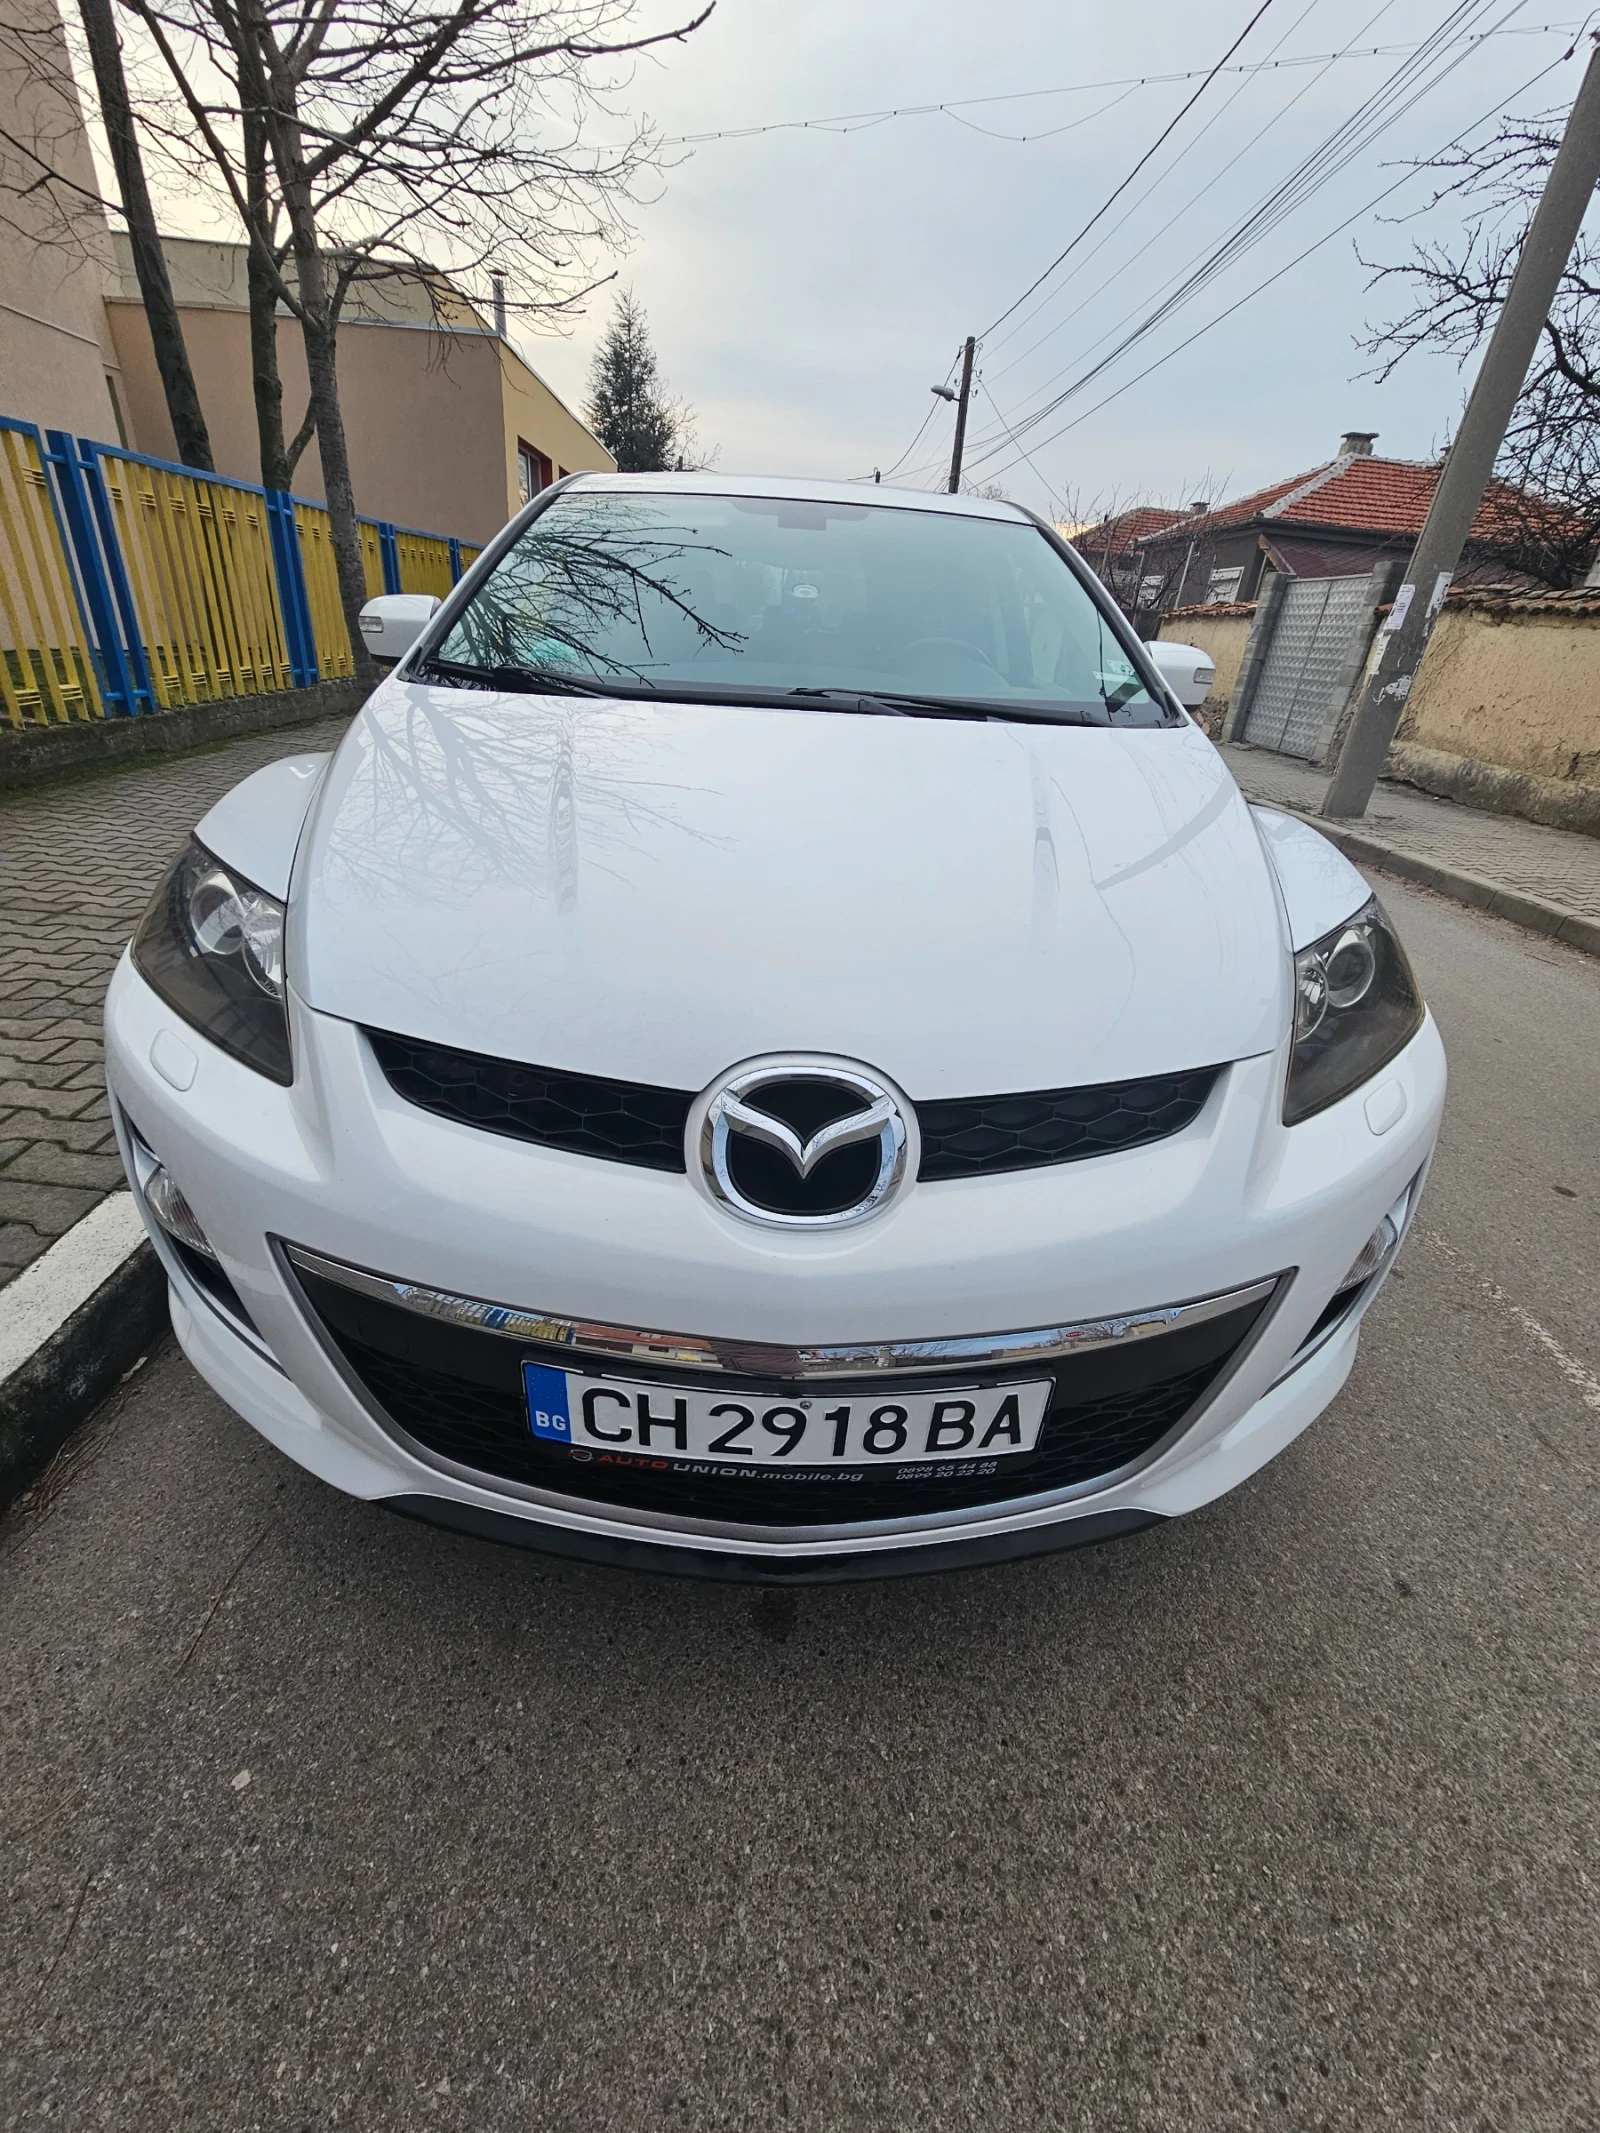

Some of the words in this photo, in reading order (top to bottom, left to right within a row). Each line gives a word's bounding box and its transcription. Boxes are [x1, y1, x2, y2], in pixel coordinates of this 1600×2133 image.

[535, 1410, 566, 1431] BG
[582, 1388, 688, 1450] CH
[708, 1403, 908, 1457] 2918
[924, 1394, 1022, 1453] BA
[896, 1472, 932, 1480] 0899
[977, 1467, 996, 1475] 20
[898, 1466, 934, 1474] 0898
[936, 1464, 956, 1472] 65
